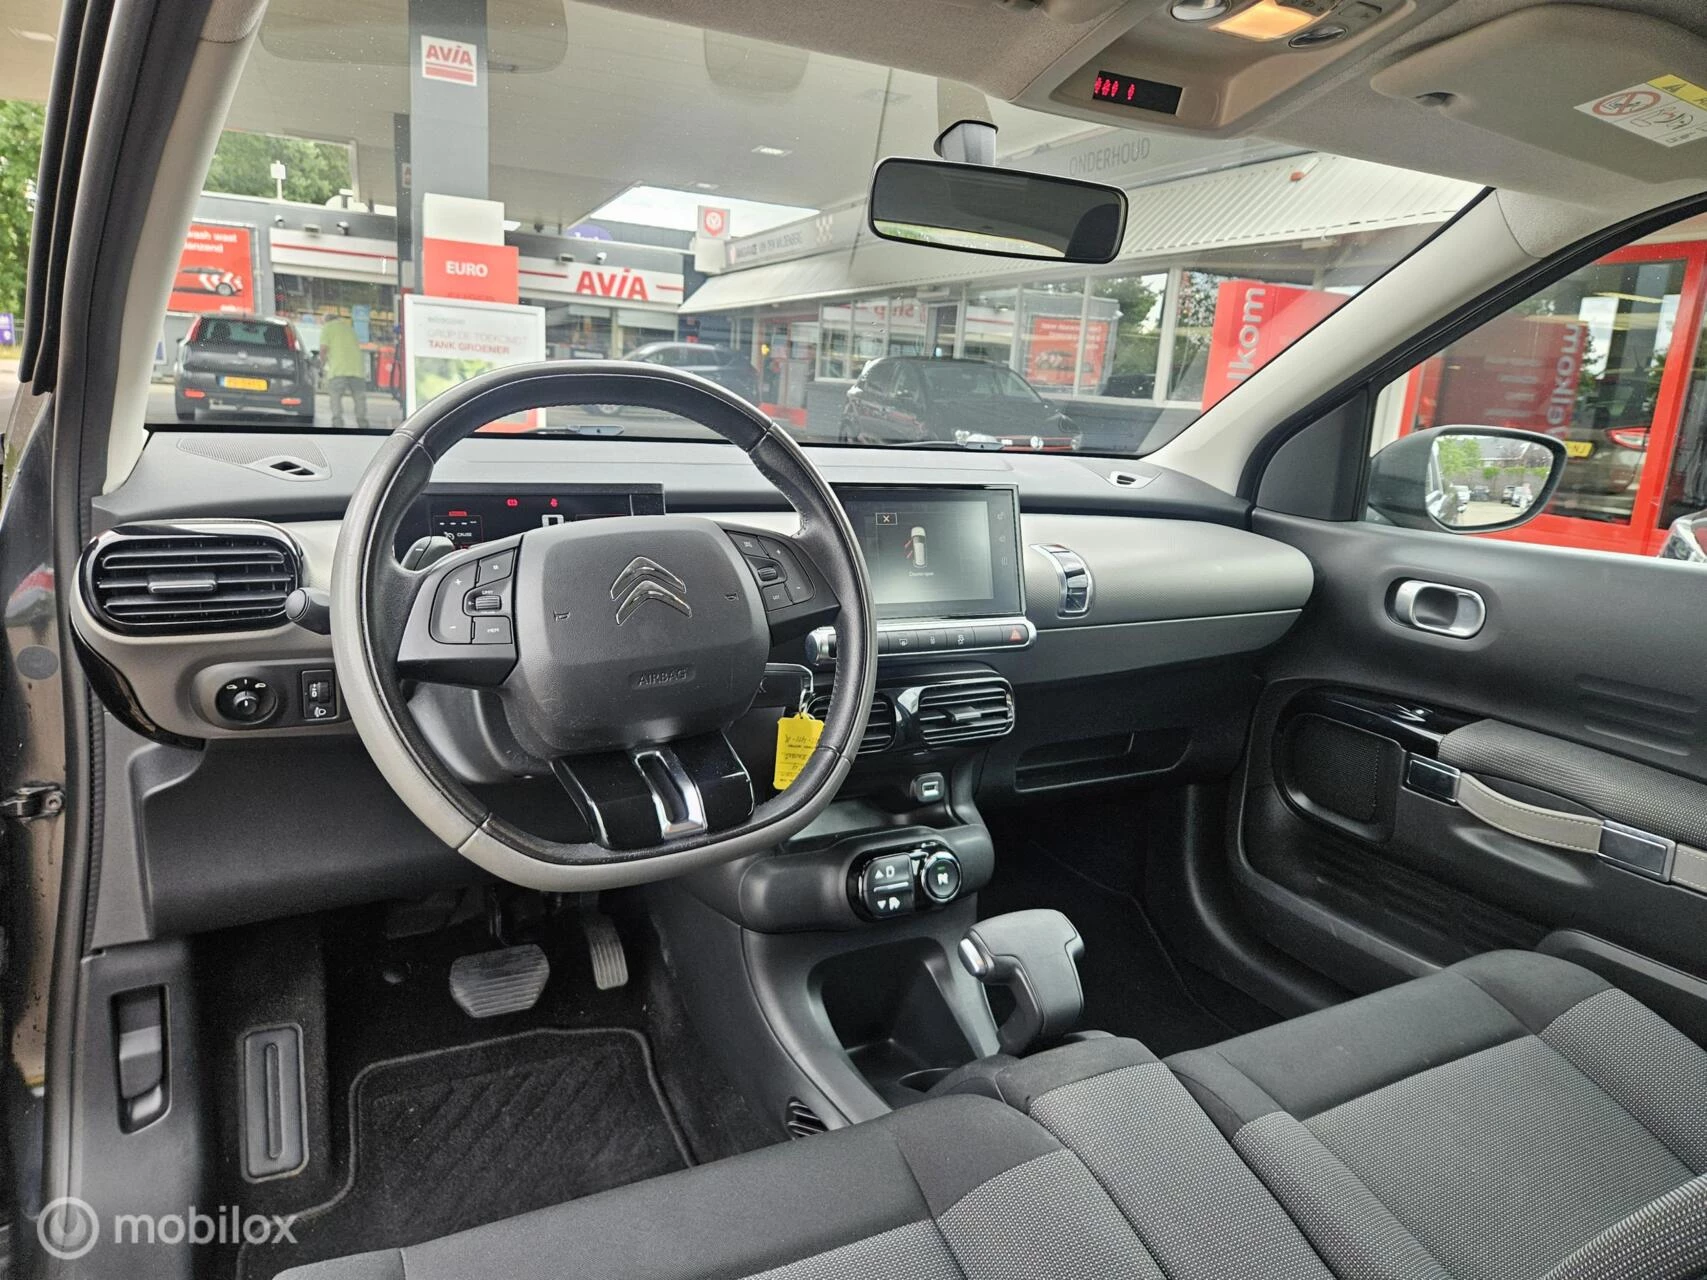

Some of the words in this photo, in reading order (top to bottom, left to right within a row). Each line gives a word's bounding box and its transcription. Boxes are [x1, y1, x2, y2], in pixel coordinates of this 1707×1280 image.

[1068, 137, 1151, 177] ONDERHOUD
[445, 260, 489, 278] EURO
[637, 667, 688, 687] AIRBAG
[885, 865, 896, 879] D
